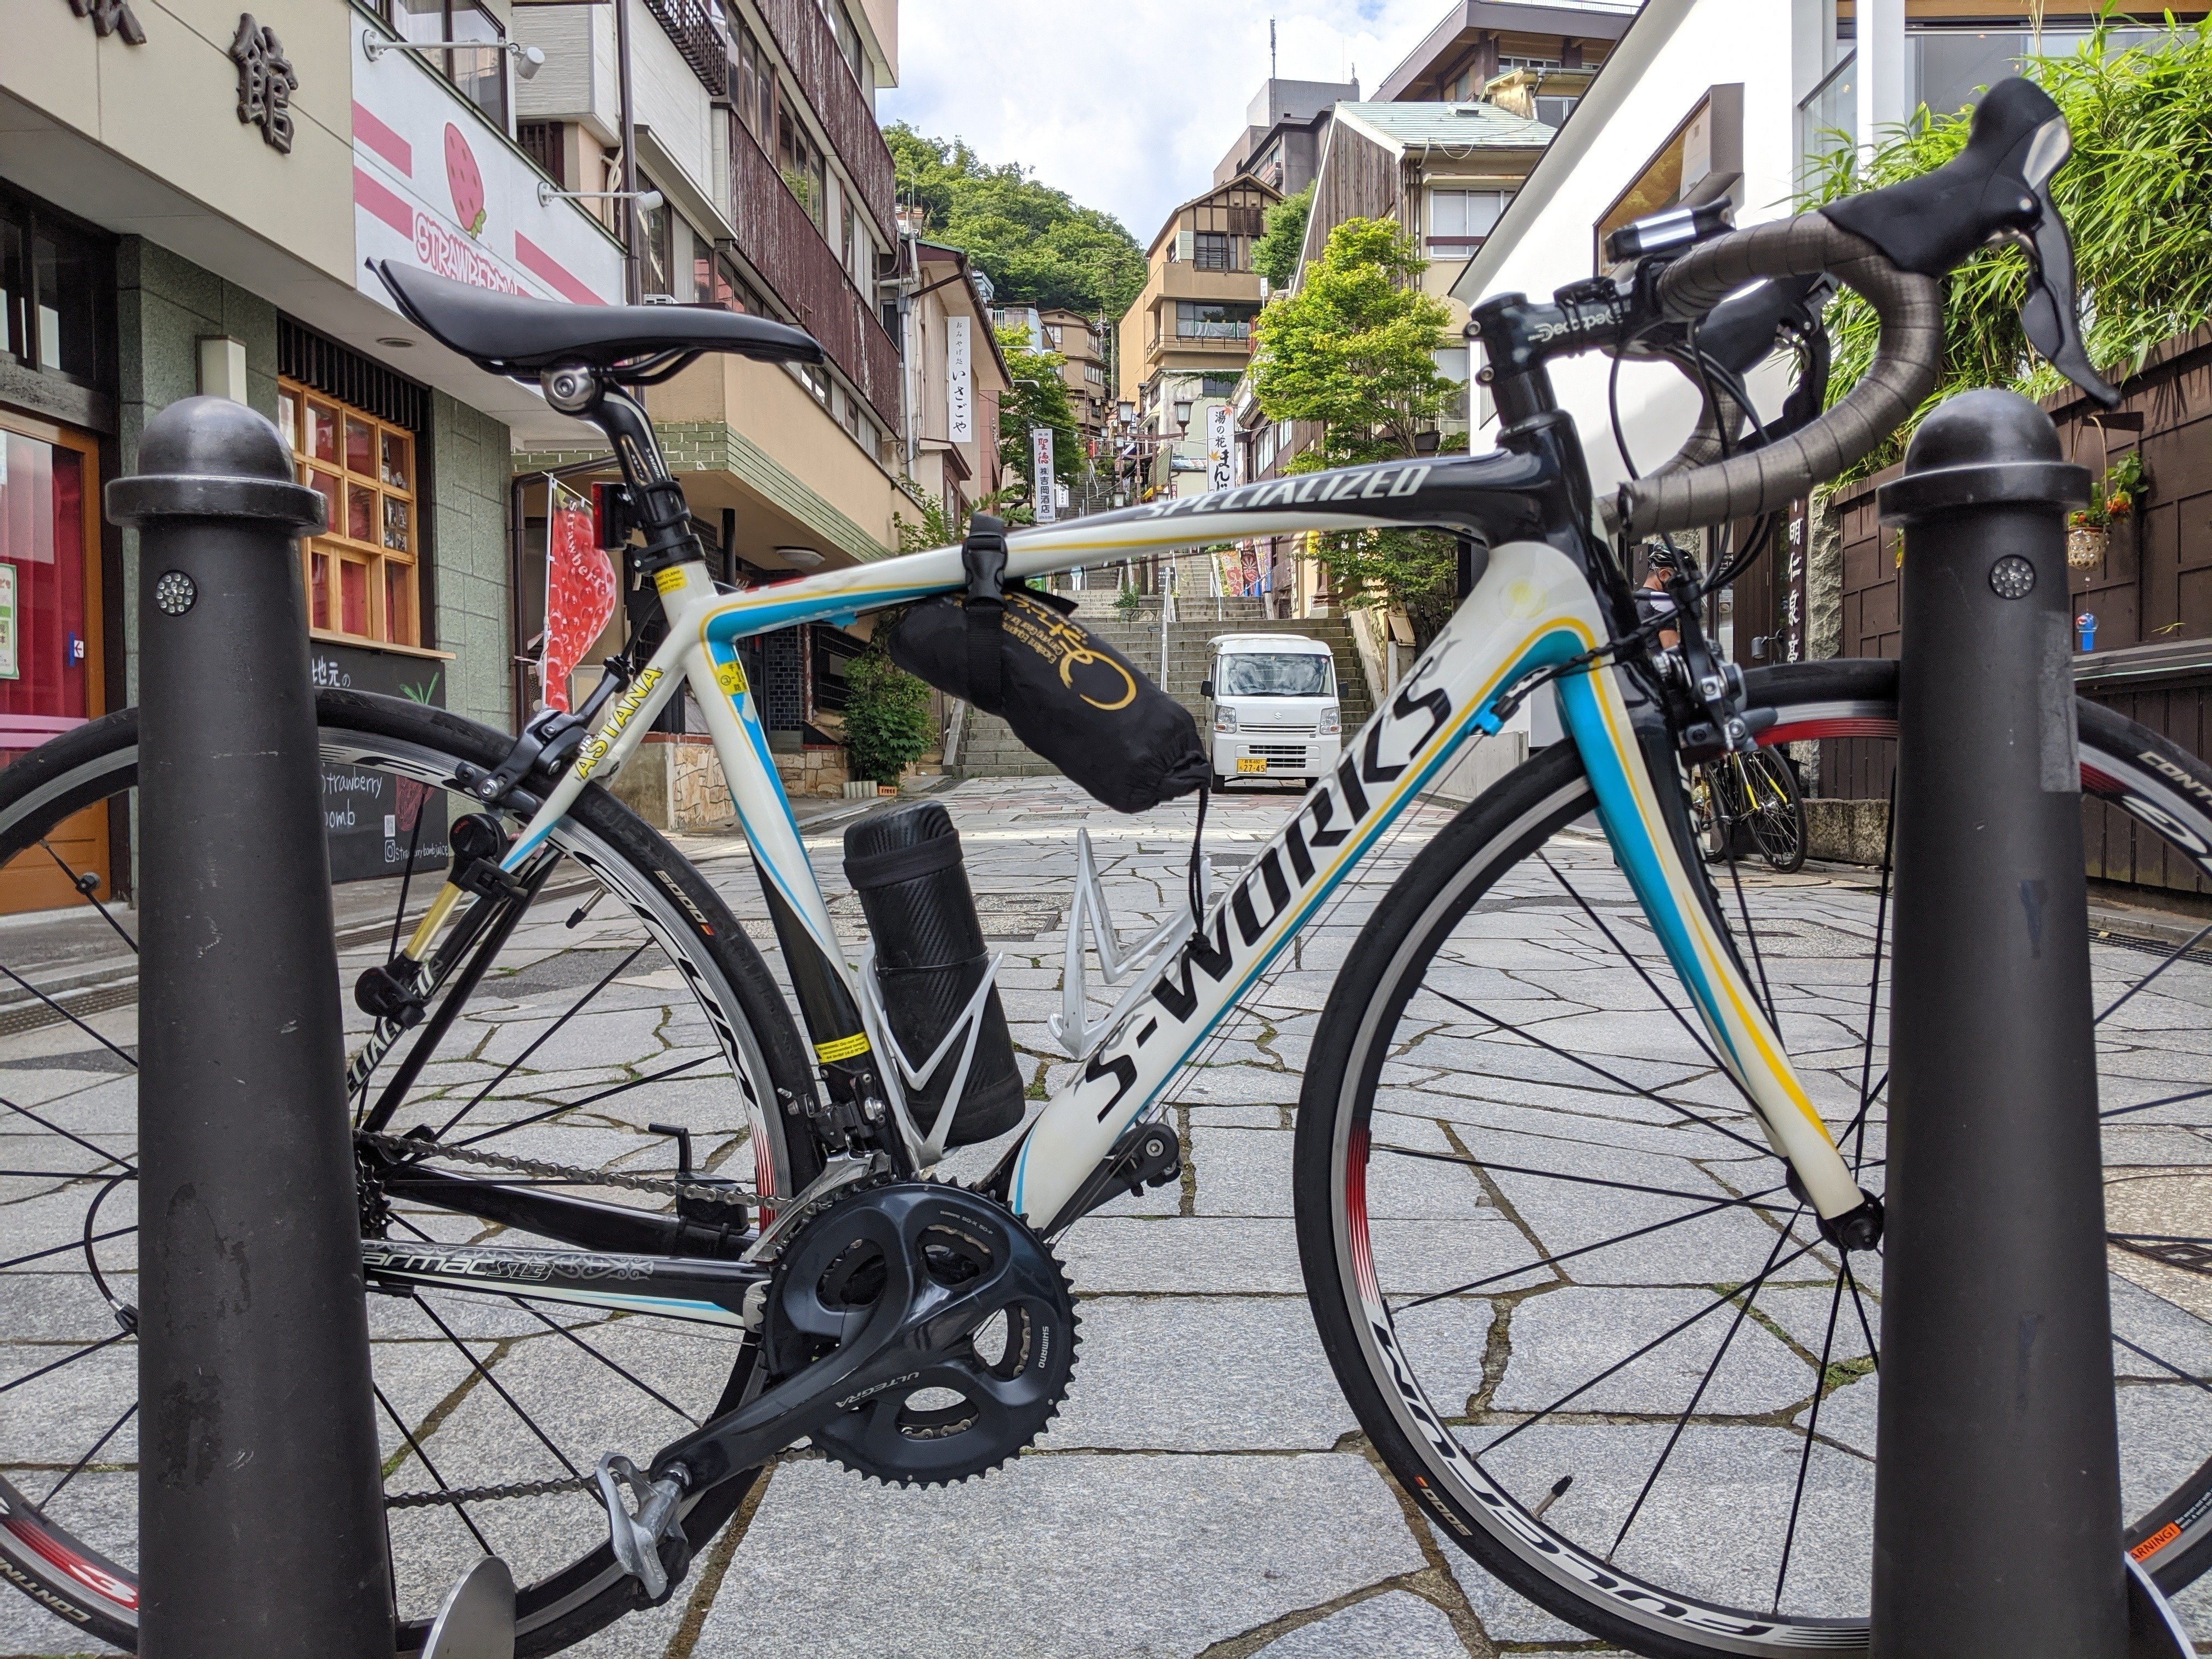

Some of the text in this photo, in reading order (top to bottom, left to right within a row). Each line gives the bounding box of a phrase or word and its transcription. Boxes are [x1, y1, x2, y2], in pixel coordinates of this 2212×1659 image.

[952, 370, 967, 433] いさごや
[1135, 465, 1432, 520] SPECIALIZED
[575, 668, 664, 780] ASTANA
[654, 870, 708, 924] 5000
[1085, 657, 1452, 1124] S-WORKS
[362, 1251, 495, 1277] armac
[1038, 1325, 1049, 1369] SHIMANO
[835, 1371, 920, 1408] ULTEGRA
[1422, 1487, 1473, 1537] 5000
[2130, 1526, 2177, 1560] ARNING!
